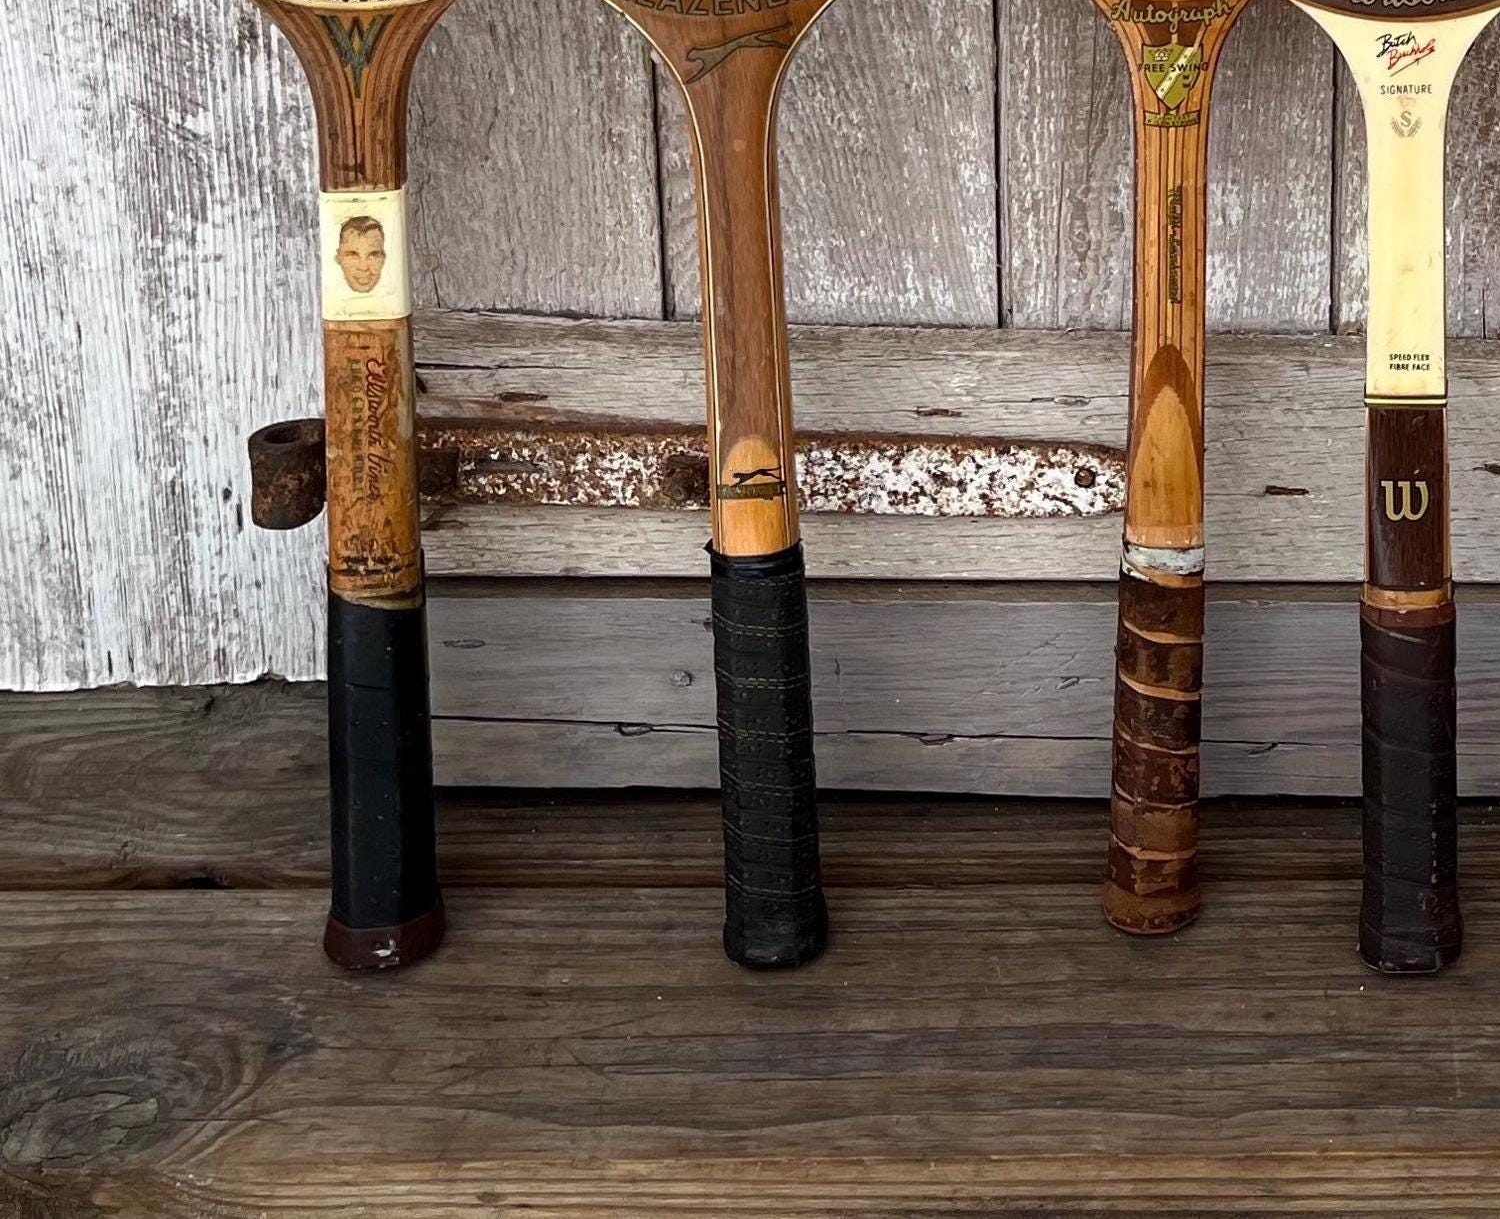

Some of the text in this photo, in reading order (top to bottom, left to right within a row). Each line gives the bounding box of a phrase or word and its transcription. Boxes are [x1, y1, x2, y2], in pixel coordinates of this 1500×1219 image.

[1138, 62, 1209, 73] FREE SWING
[1380, 84, 1433, 95] SIGNATURE
[1389, 353, 1412, 361] SPEED
